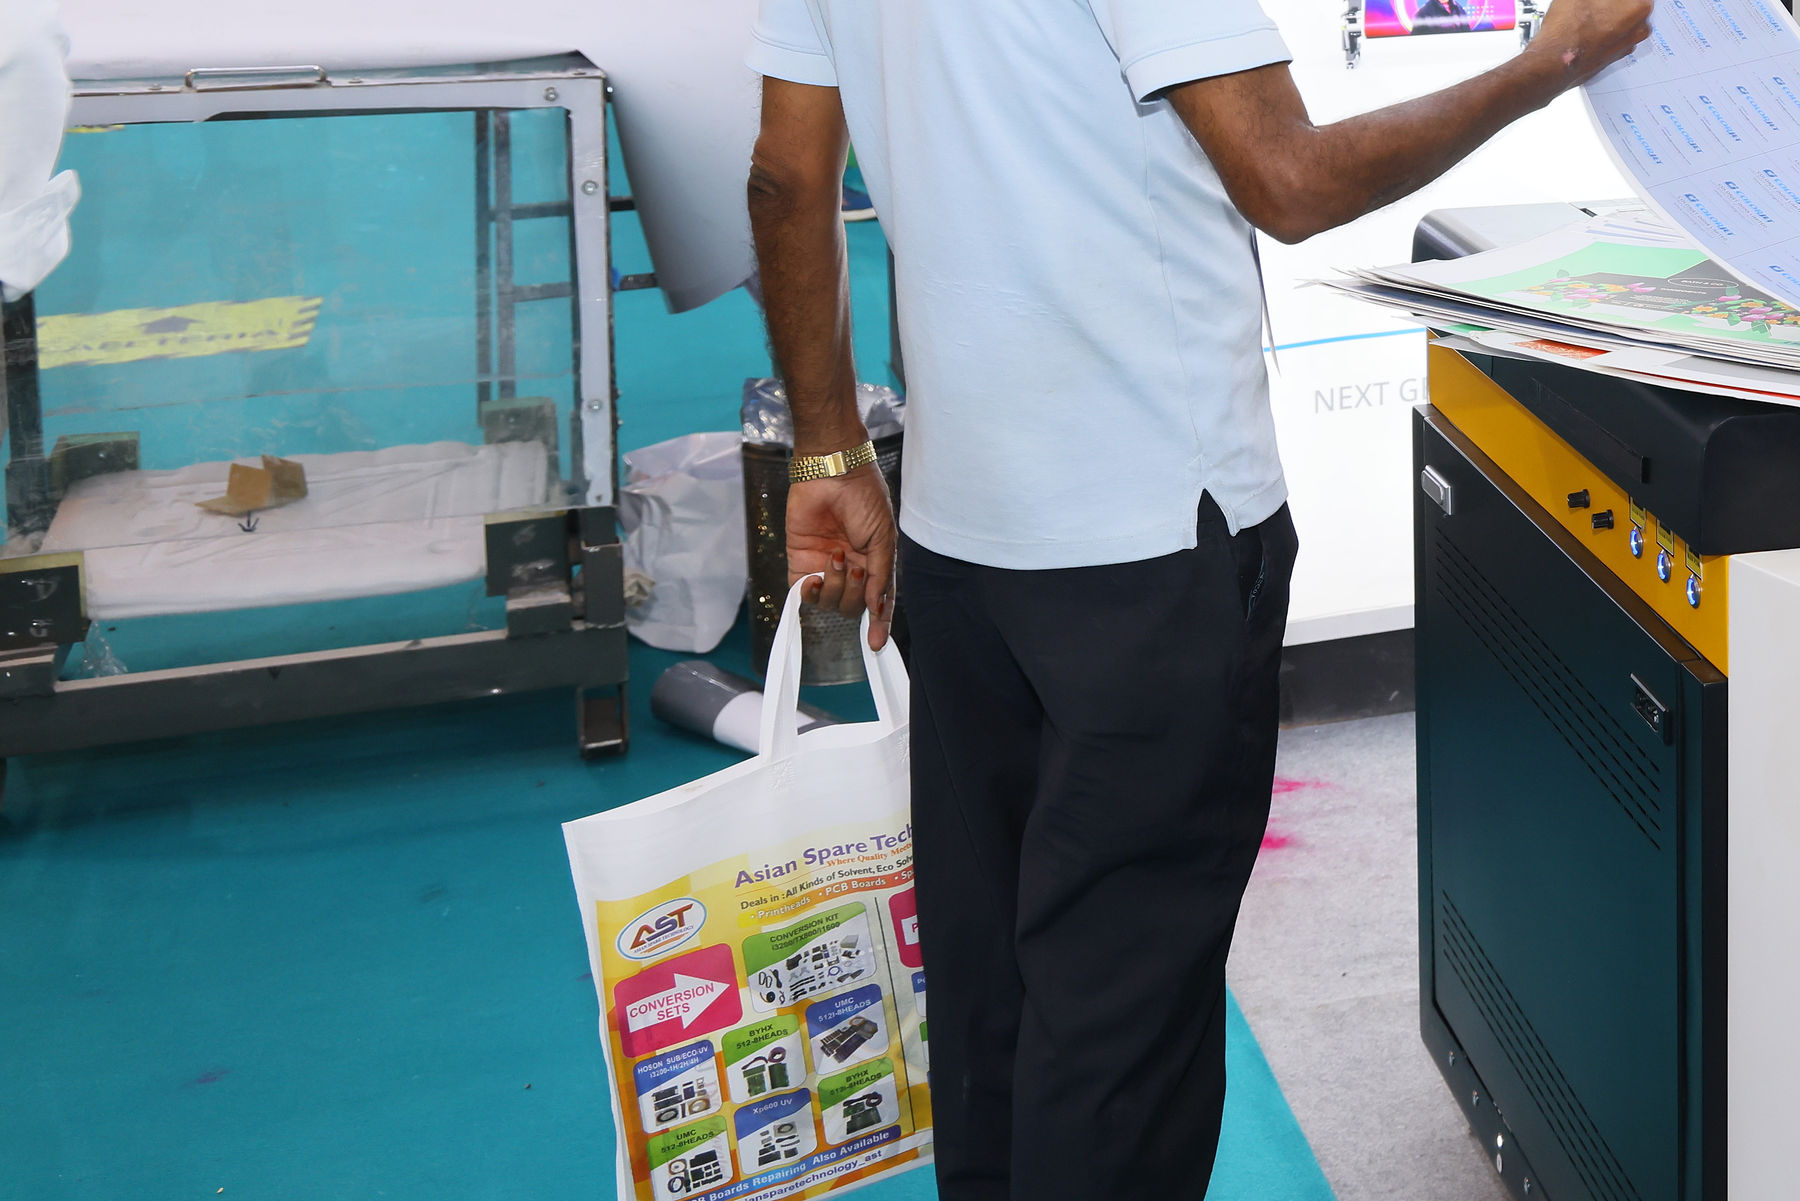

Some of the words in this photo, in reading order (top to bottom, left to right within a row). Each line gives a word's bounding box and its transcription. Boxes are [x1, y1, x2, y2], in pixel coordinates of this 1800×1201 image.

[1314, 381, 1390, 414] NEXT
[734, 859, 797, 889] Asian
[803, 840, 868, 866] Spare
[826, 854, 856, 867] Where
[857, 851, 888, 864] Quality
[740, 896, 768, 910] Deals
[769, 893, 780, 903] in
[799, 877, 824, 894] Kinds
[826, 871, 837, 883] of
[837, 866, 876, 879] Solvent,
[876, 863, 894, 873] Eco
[757, 896, 811, 919] Printheads
[825, 882, 849, 897] PCB
[851, 877, 887, 890] Boards
[630, 903, 694, 950] AST
[770, 918, 824, 943] CONVERSION
[825, 912, 839, 923] KIT
[629, 982, 715, 1018] CONVERSION
[656, 1002, 691, 1021] SETS
[834, 997, 855, 1009] UMC
[749, 1023, 774, 1037] BYHX
[637, 1060, 664, 1074] HOSON
[780, 1098, 794, 1107] UV
[676, 1129, 697, 1141] UMC
[709, 1182, 750, 1201] Boards
[752, 1162, 807, 1187] Repairing
[812, 1150, 837, 1166] Also
[840, 1131, 890, 1156] Available
